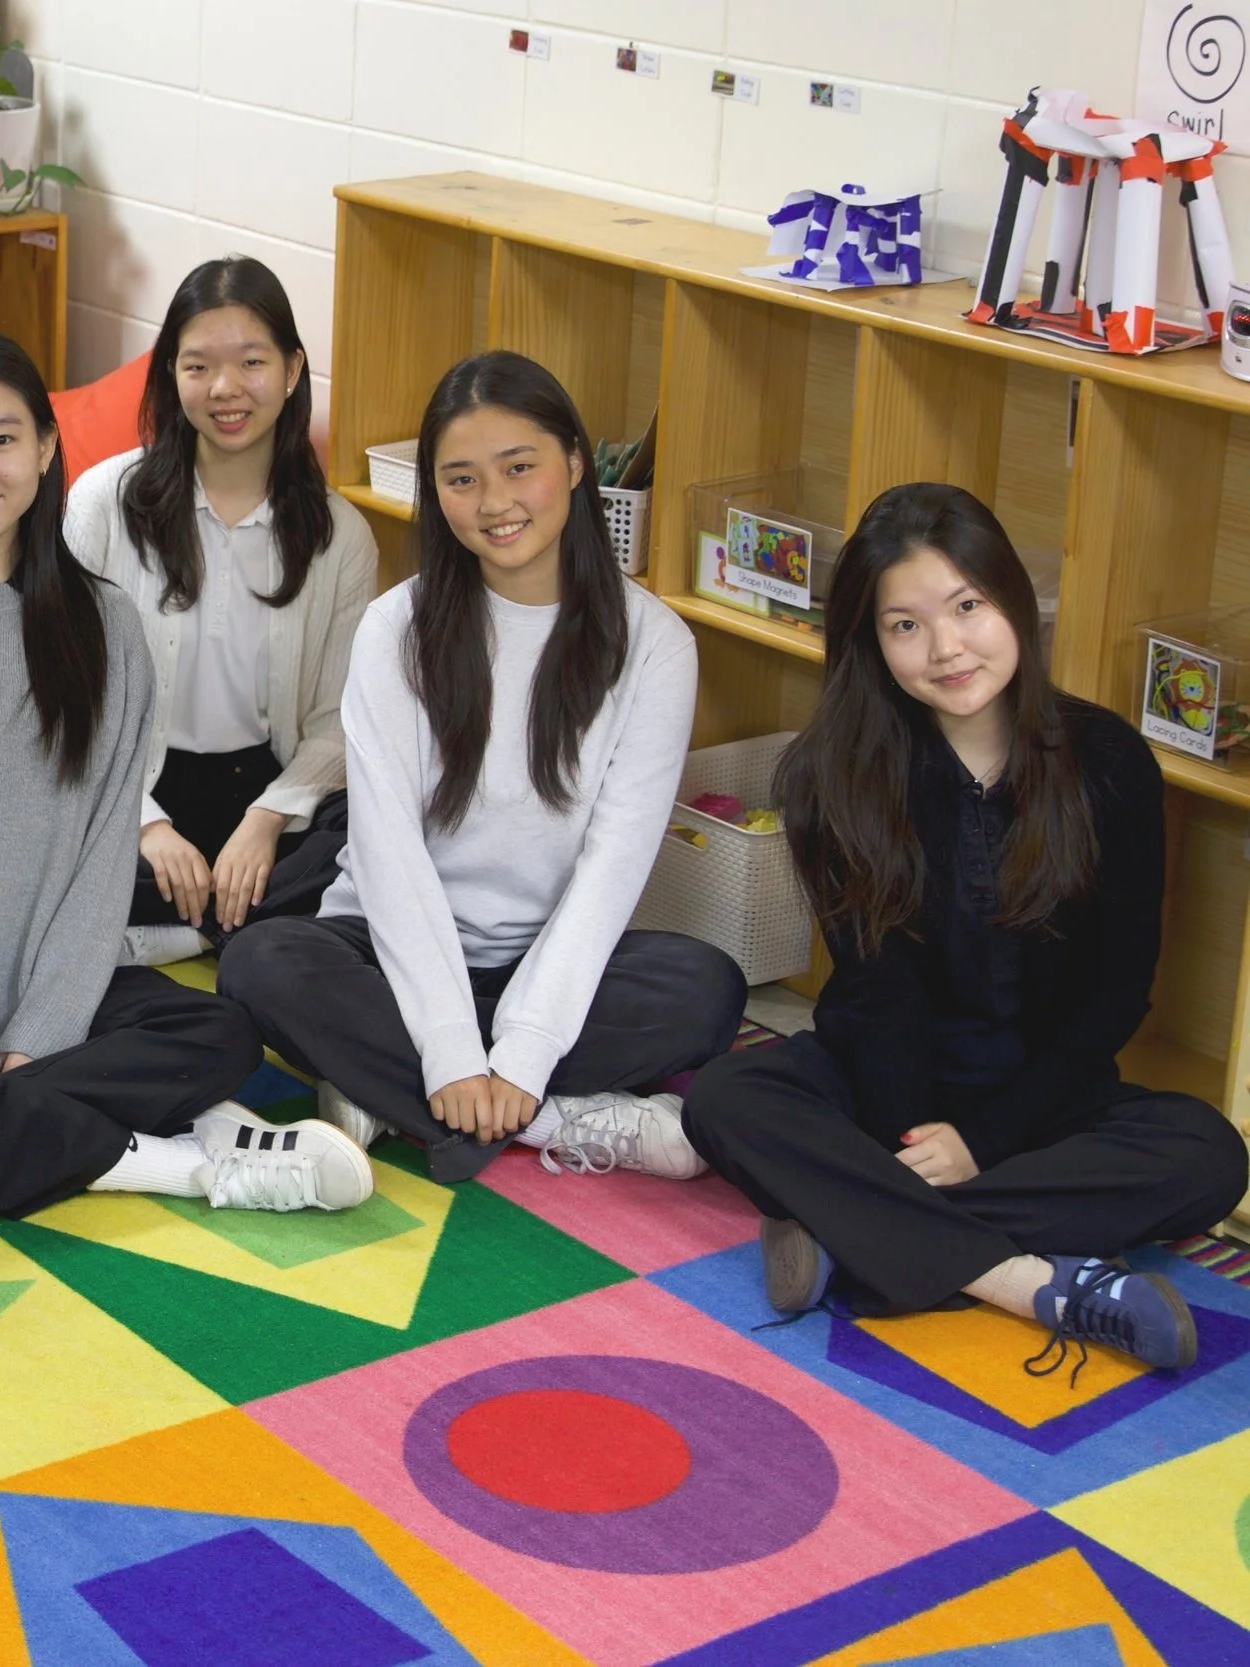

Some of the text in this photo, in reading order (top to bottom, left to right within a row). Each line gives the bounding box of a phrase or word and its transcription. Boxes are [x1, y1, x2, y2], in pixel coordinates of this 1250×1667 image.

[738, 570, 798, 600] Shape Magnets
[1148, 718, 1208, 753] Lacing Cards
